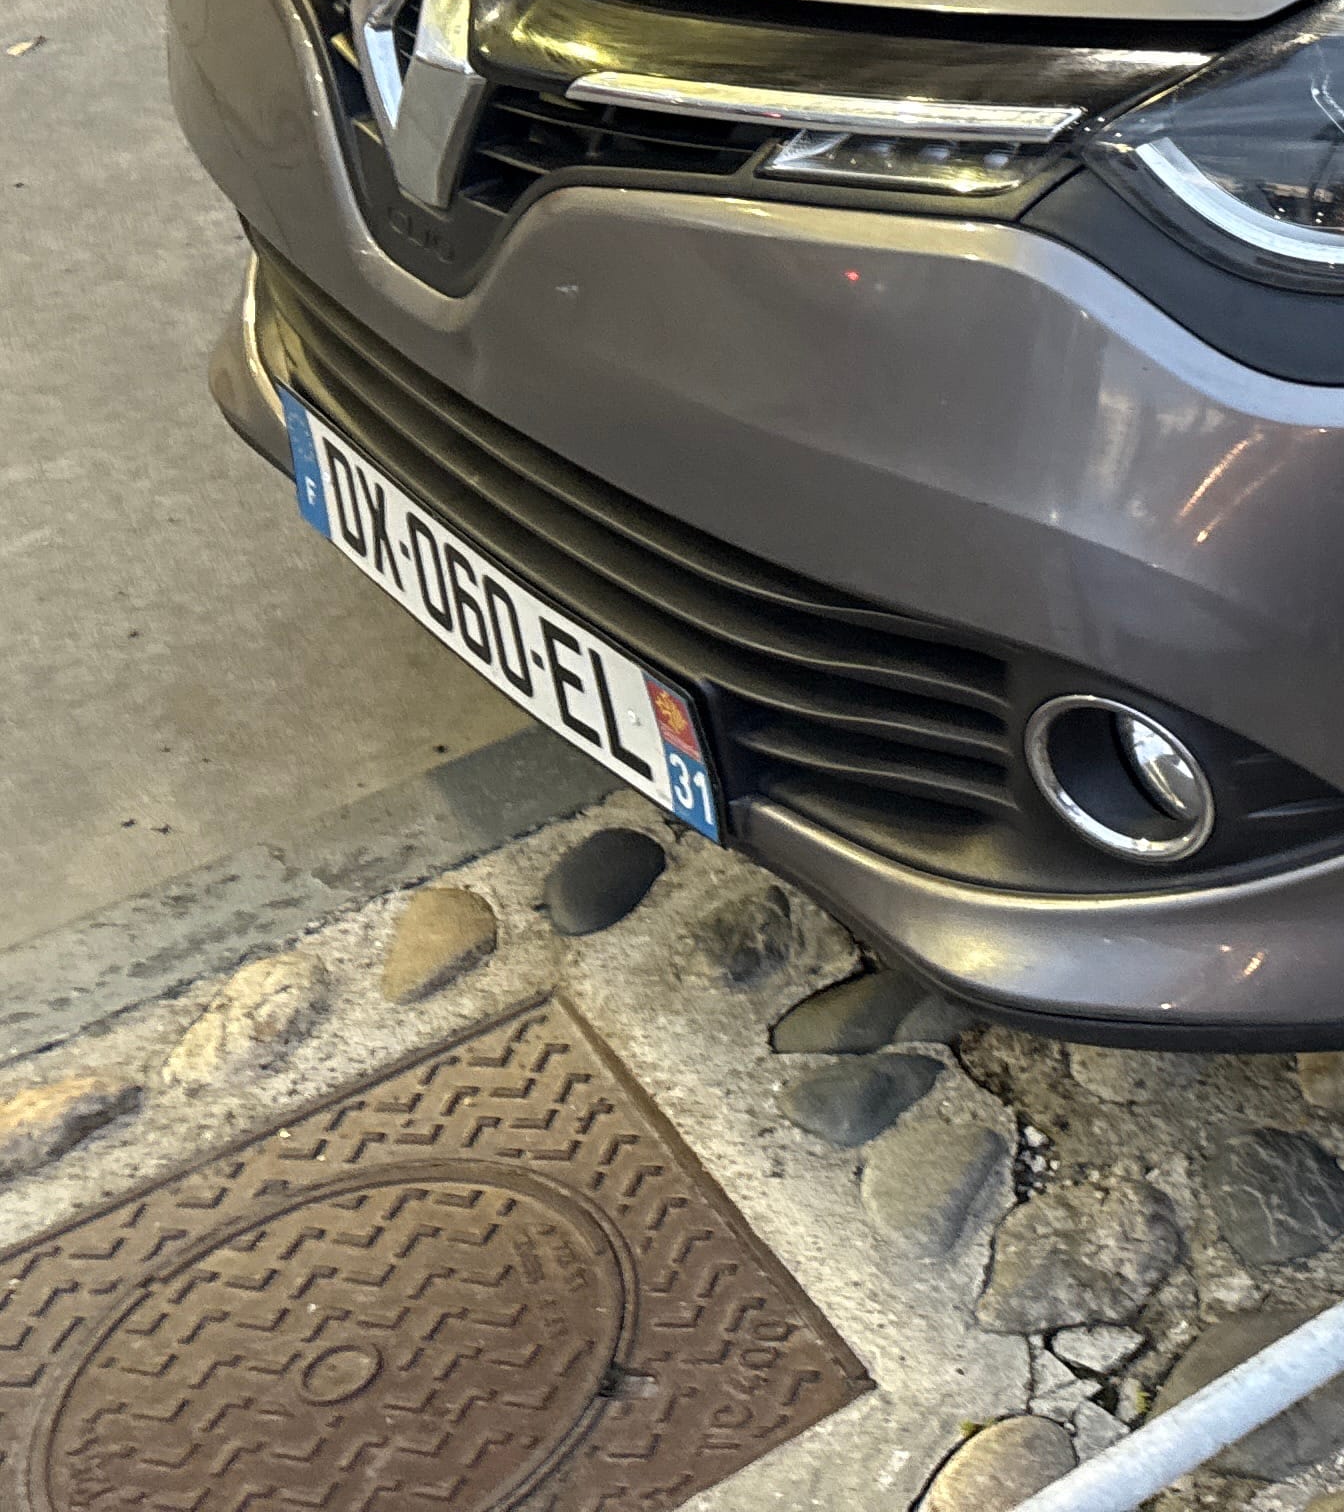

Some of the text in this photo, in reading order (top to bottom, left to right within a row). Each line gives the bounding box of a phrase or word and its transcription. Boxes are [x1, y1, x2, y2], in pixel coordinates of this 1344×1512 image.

[386, 204, 457, 265] CLIO
[304, 475, 317, 506] F
[322, 435, 654, 784] DX-060-EL
[669, 752, 715, 826] 31
